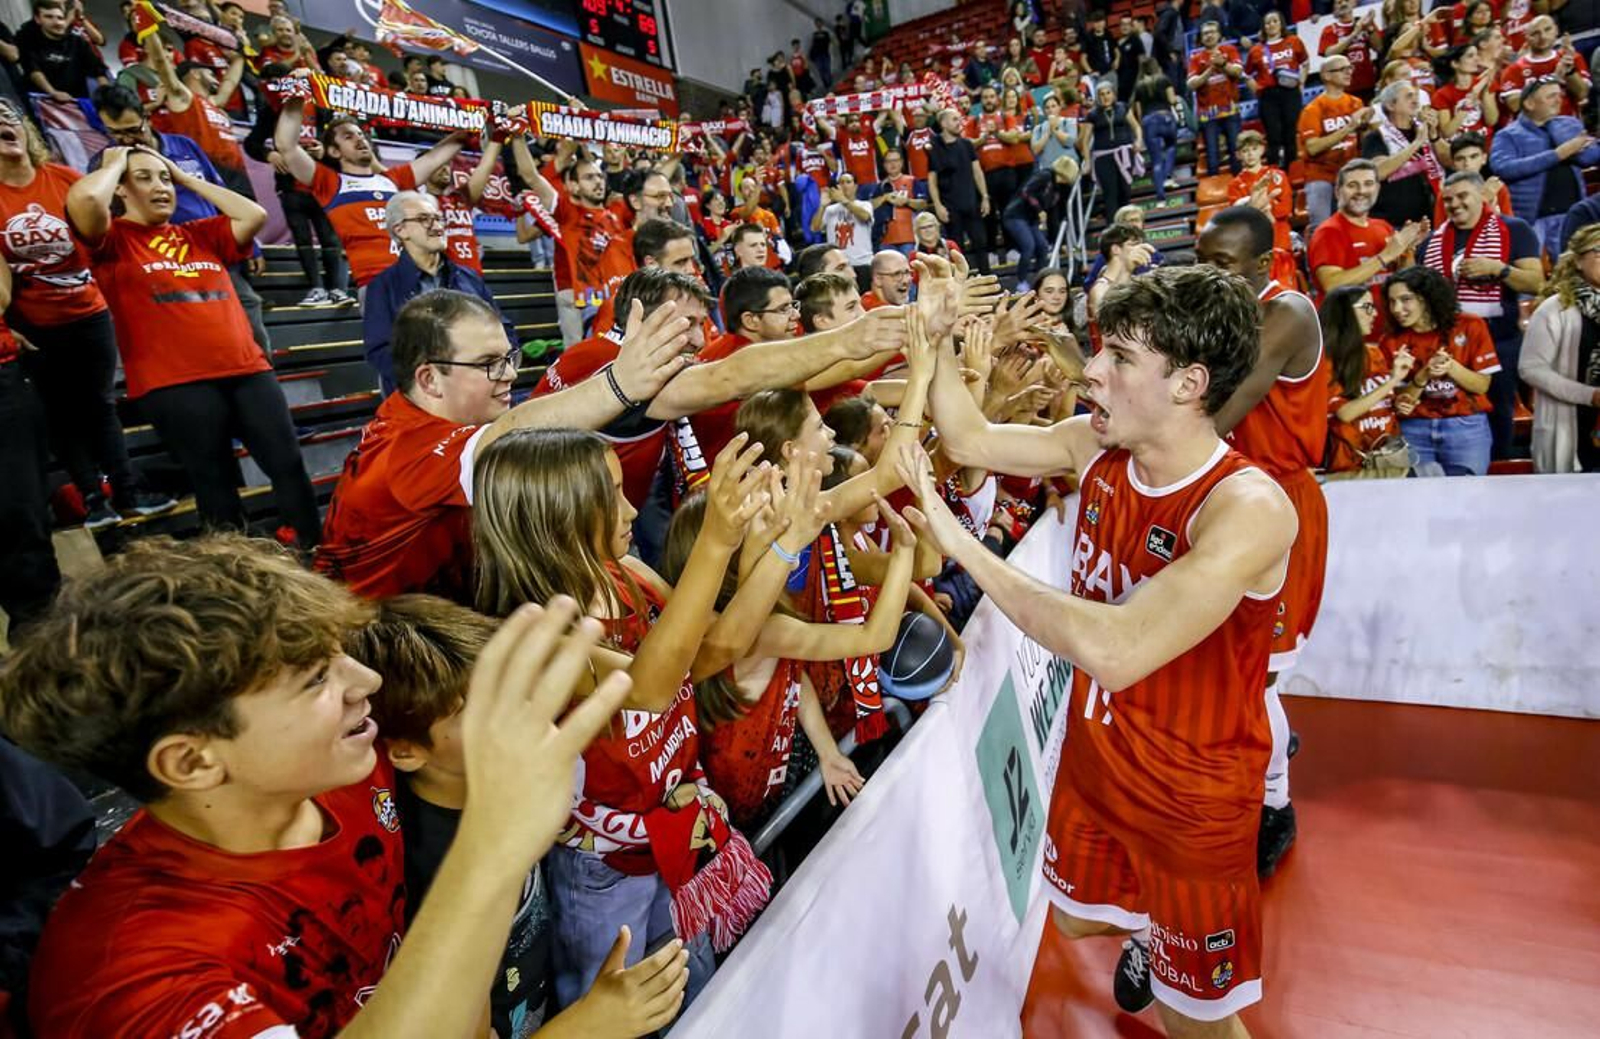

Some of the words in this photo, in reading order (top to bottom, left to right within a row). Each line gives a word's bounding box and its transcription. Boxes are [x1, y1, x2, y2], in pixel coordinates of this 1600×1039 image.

[464, 23, 498, 41] TOYOTA
[498, 34, 530, 51] TALLERS
[610, 66, 675, 100] ESTRELLA
[327, 83, 390, 118] GRADA
[541, 111, 592, 137] GRADA
[440, 208, 473, 226] AXI
[454, 241, 474, 260] 55
[1029, 677, 1053, 755] WE
